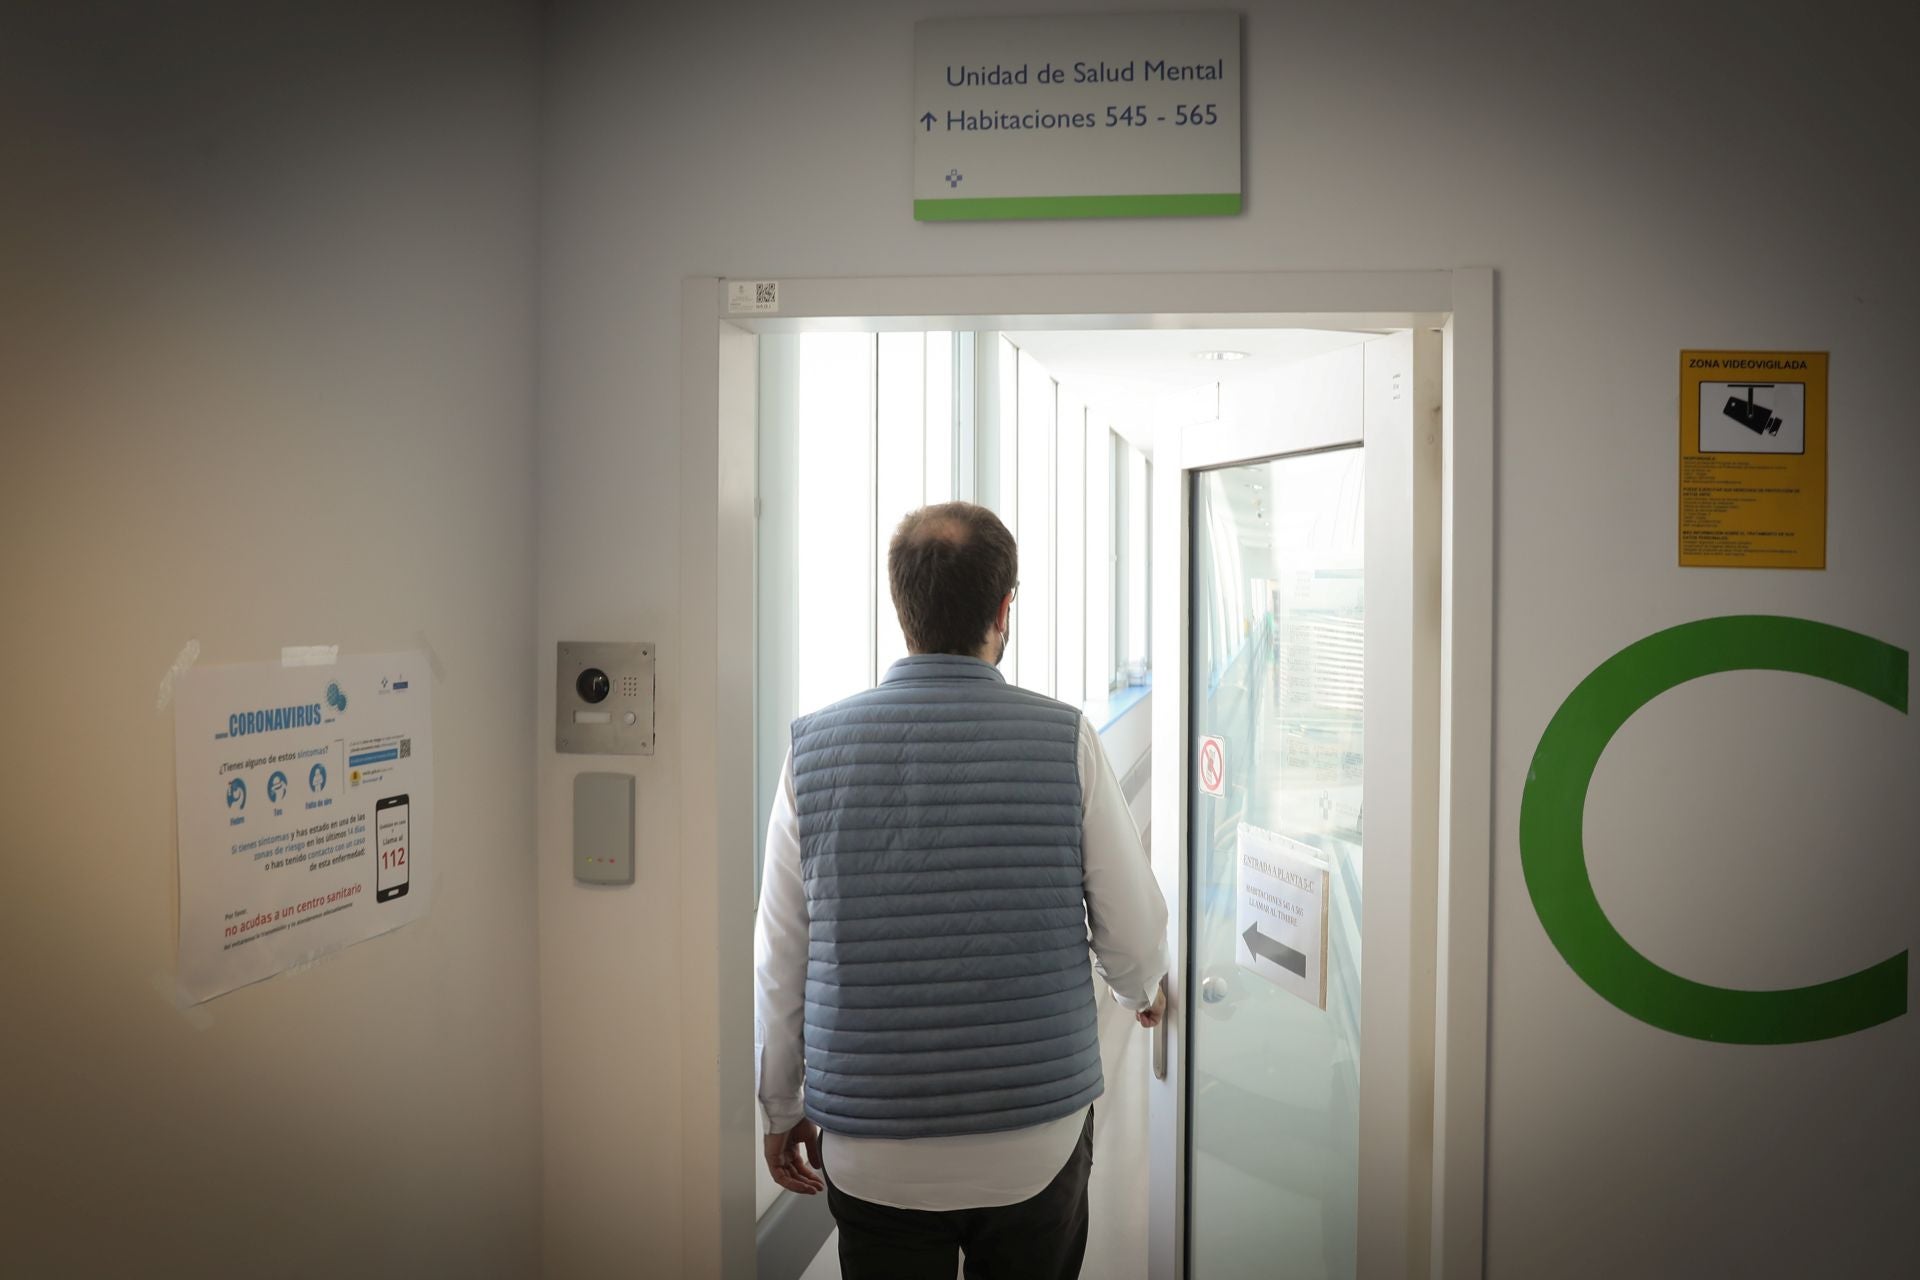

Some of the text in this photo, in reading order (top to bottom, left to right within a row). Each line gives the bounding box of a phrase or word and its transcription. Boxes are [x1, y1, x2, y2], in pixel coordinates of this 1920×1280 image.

[946, 59, 1223, 87] Unidad de Salud Mental
[946, 109, 1095, 131] Habitaciones
[1105, 105, 1148, 127] 545
[1175, 104, 1217, 126] 565
[1689, 359, 1807, 370] ZONA VIDEOVIGILADA
[229, 704, 321, 737] CORONAVIRUS
[245, 757, 267, 770] alguno
[268, 754, 276, 764] de
[278, 752, 296, 761] estos
[309, 822, 330, 835] estado
[270, 859, 284, 870] has
[285, 853, 307, 866] tenido
[382, 847, 405, 870] 112
[224, 925, 238, 938] no
[239, 912, 272, 932] acudas
[274, 910, 280, 921] a
[282, 906, 294, 918] un
[296, 895, 325, 914] centro
[326, 882, 362, 904] sanitario
